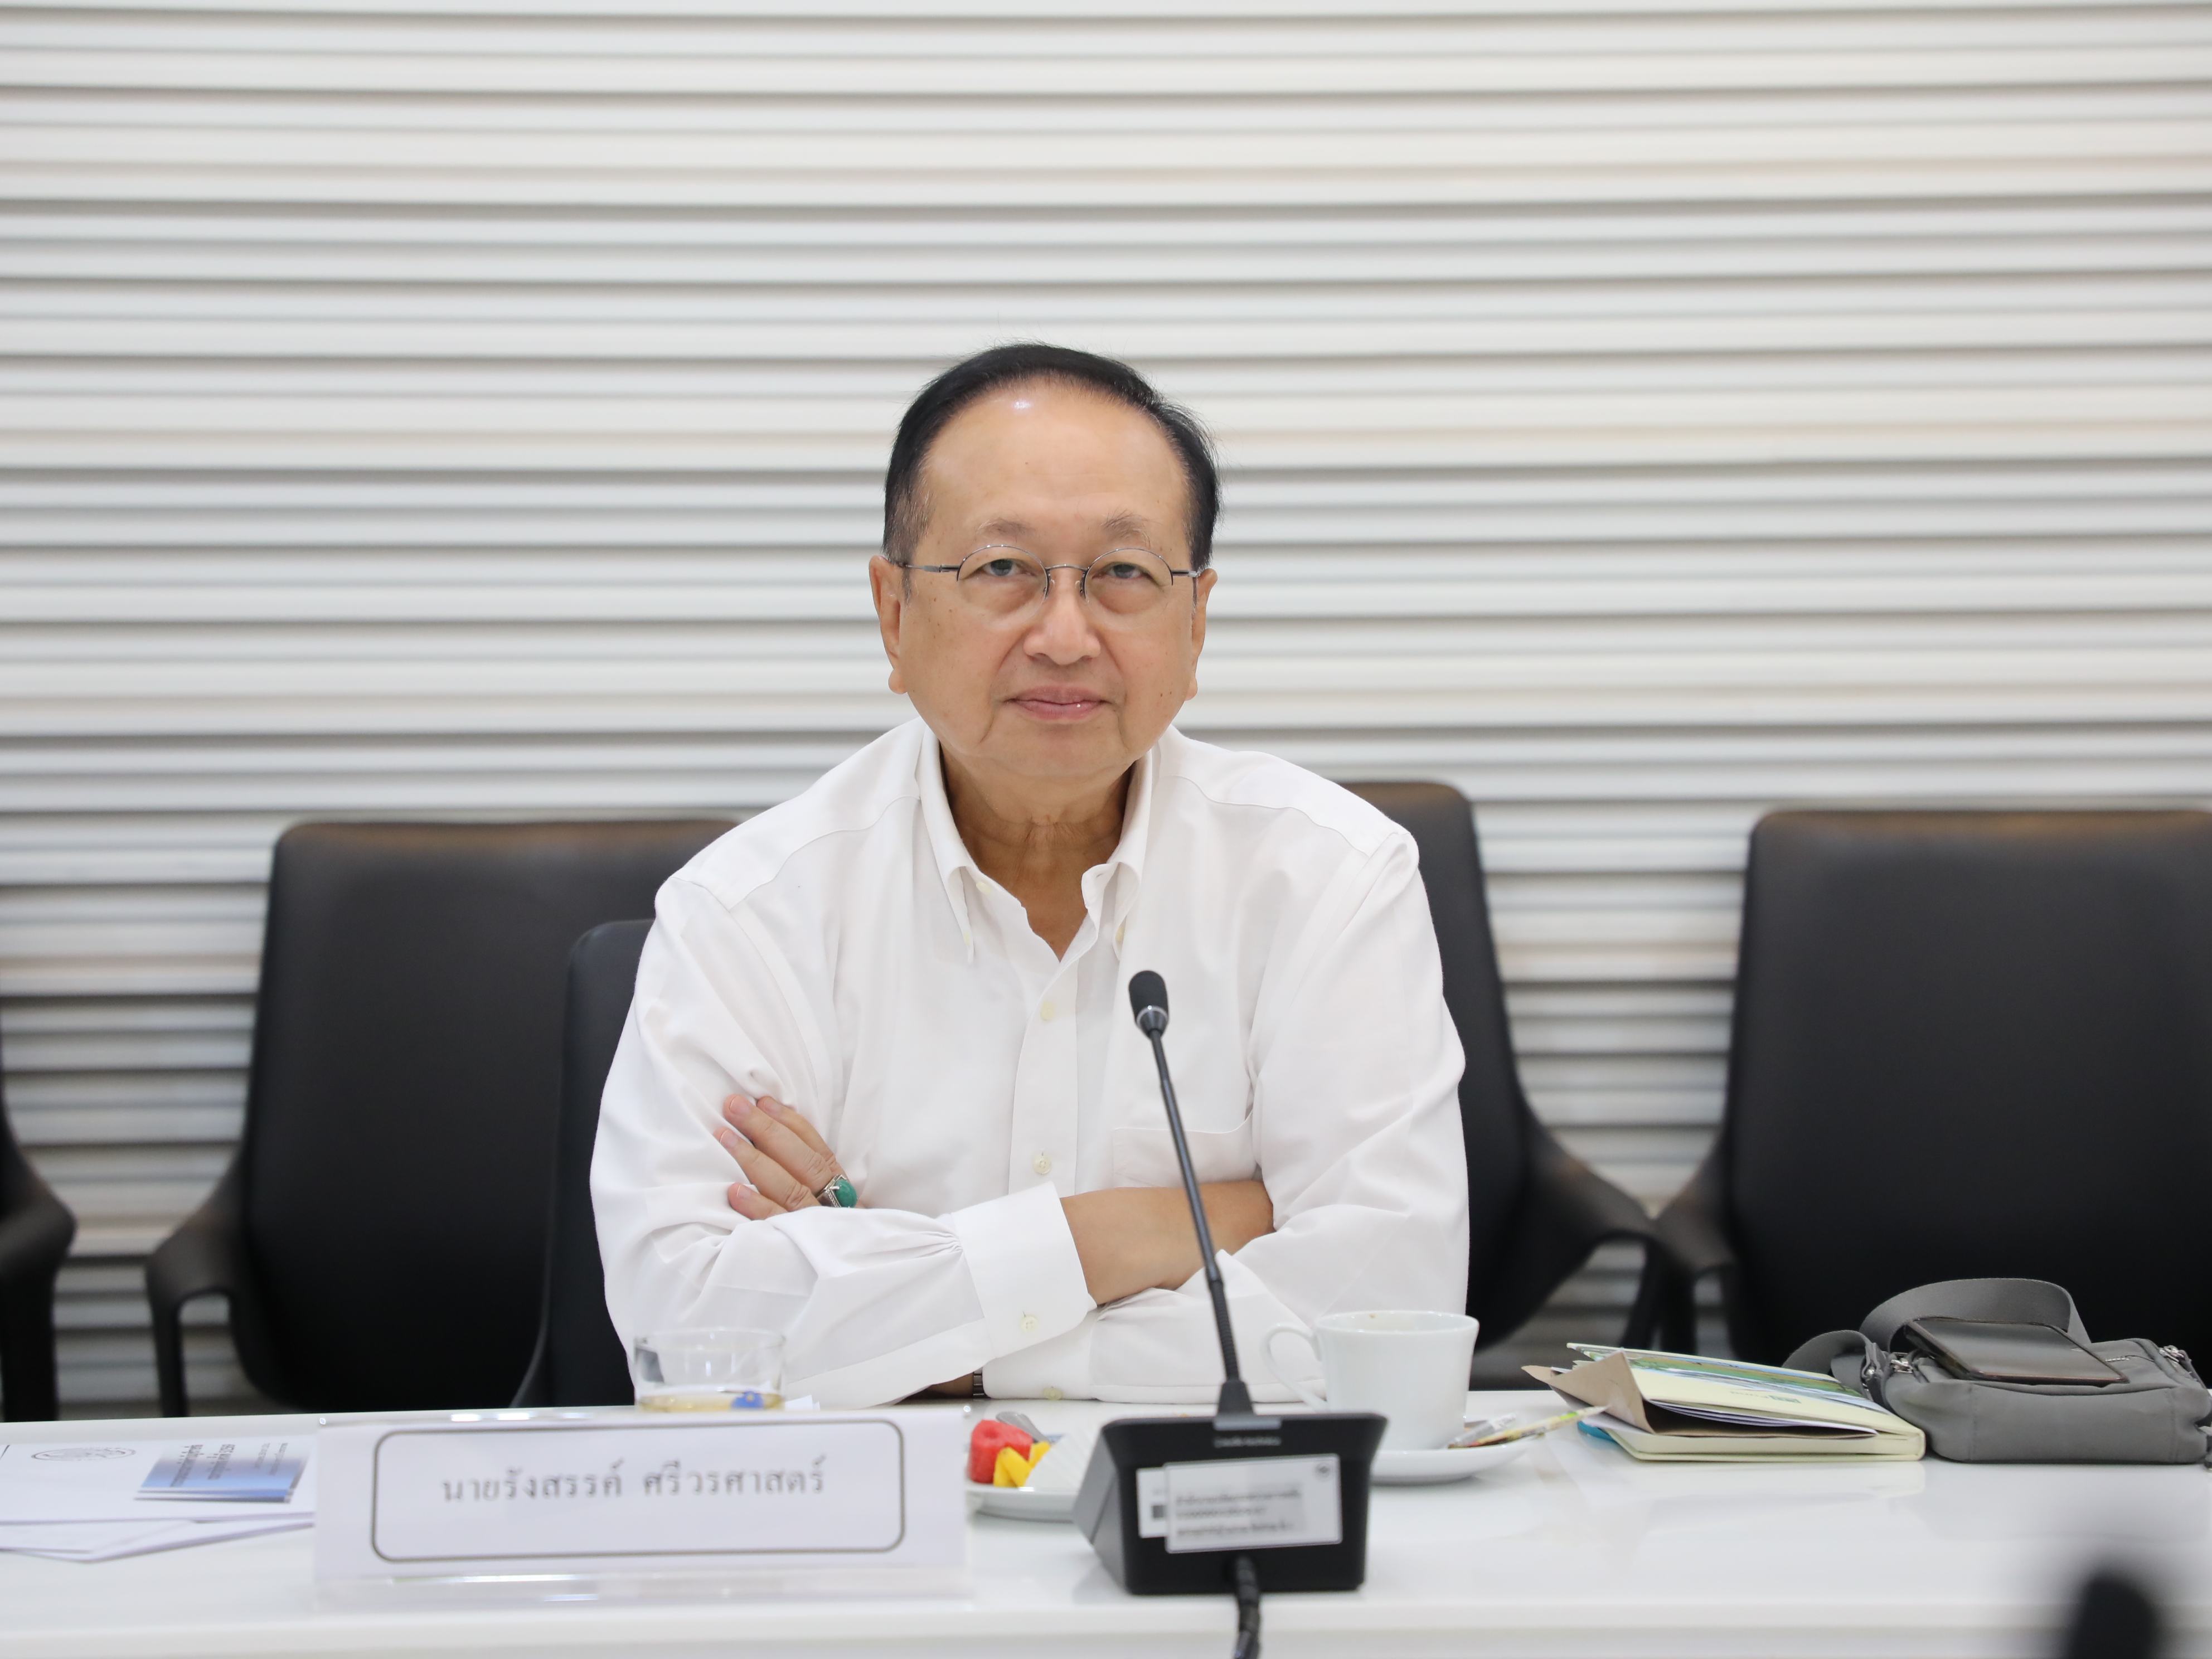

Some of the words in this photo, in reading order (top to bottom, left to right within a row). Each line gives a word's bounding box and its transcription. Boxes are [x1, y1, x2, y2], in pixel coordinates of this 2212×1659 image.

[442, 1458, 625, 1501] นายรังสรรค์
[643, 1454, 827, 1496] ศรีวรศาสตร์
